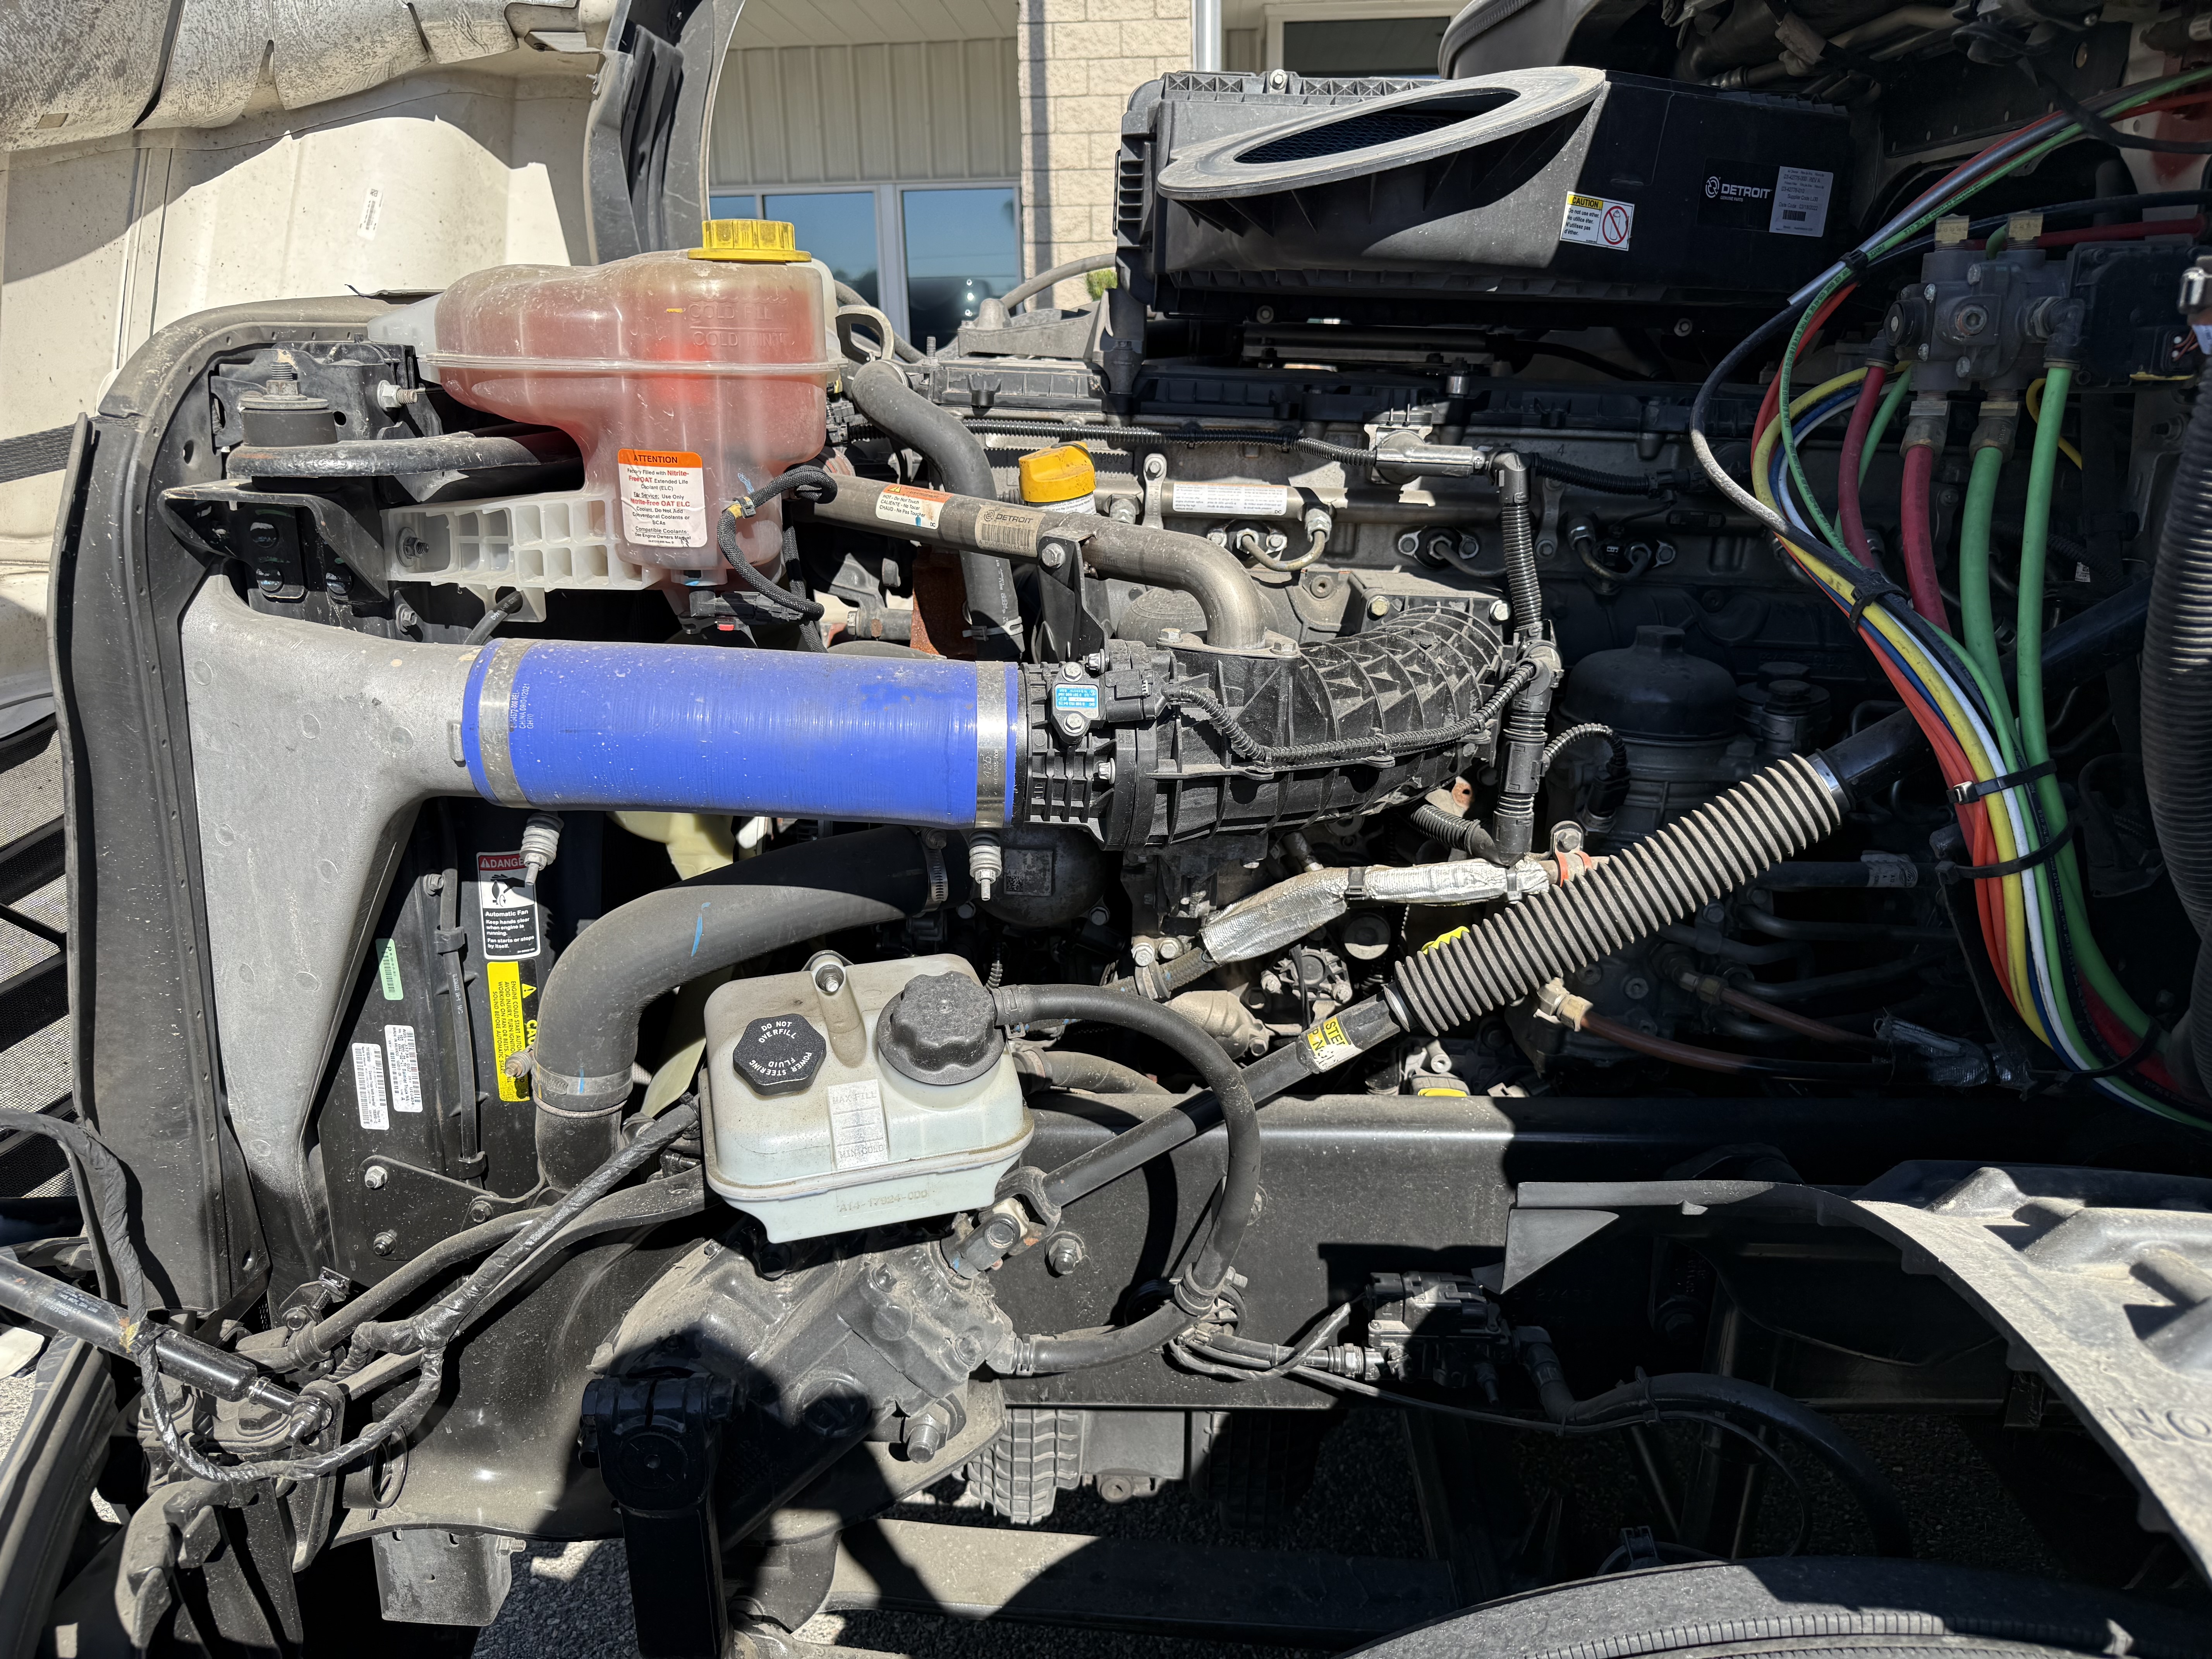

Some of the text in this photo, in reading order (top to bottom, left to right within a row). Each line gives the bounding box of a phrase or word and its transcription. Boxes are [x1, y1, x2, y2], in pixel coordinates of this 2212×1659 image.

[1721, 184, 1771, 199] DETROIT
[1572, 197, 1599, 208] CAUTION
[689, 304, 771, 320] COLD FILL
[693, 331, 738, 346] COLD
[634, 455, 678, 463] ATTENTION
[996, 514, 1033, 524] DETROIT
[517, 711, 527, 728] CHINA
[526, 713, 534, 729] GH70
[490, 856, 524, 869] DANGE
[500, 1008, 506, 1017] ON
[761, 1023, 772, 1031] DO
[758, 1029, 797, 1043] OVERFILL
[749, 1052, 812, 1076] POWER STEERING
[768, 1057, 796, 1068] FLUID
[832, 1091, 876, 1104] MAX FILL
[840, 1144, 884, 1158] MIN COLD
